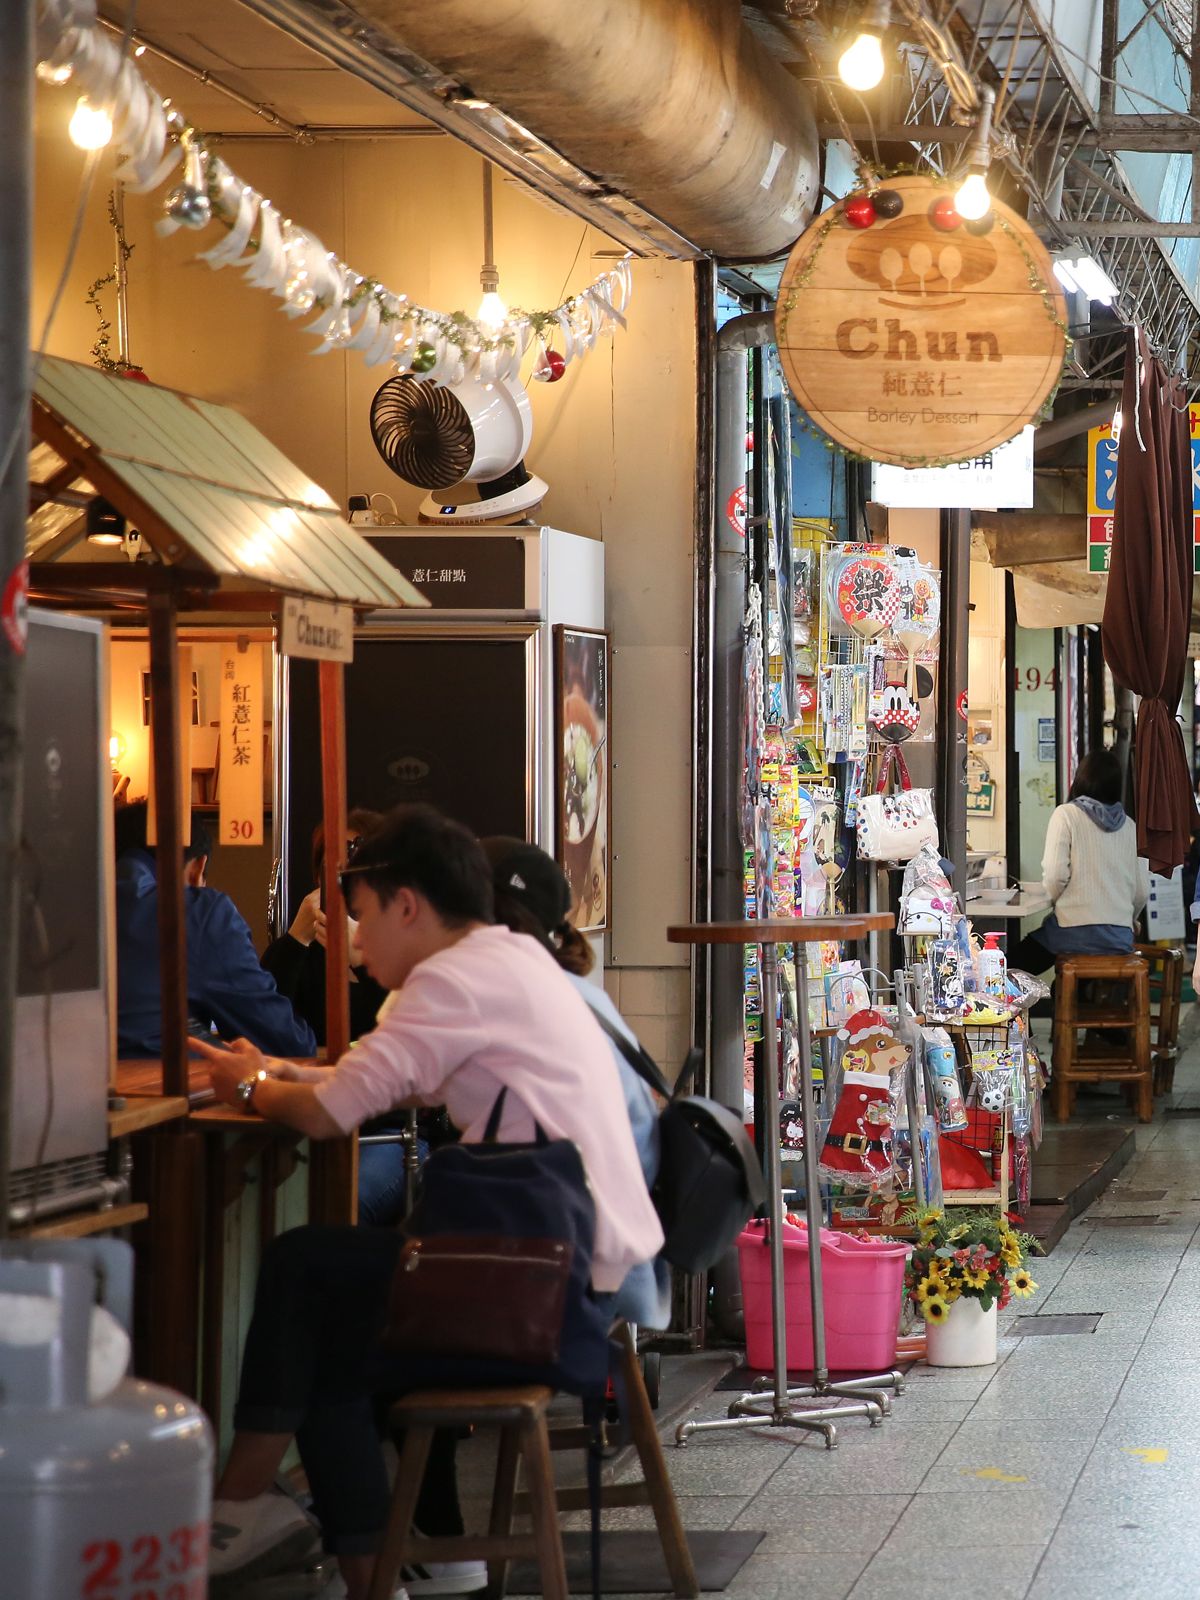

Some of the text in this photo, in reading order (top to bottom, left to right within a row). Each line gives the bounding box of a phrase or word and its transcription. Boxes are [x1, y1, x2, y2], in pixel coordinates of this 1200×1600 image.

[836, 318, 1003, 362] Chun
[882, 370, 962, 398] 純薏仁
[868, 407, 978, 425] Barley Dessert
[412, 568, 467, 583] 薏仁甜點
[232, 684, 251, 766] 紅薏仁茶
[230, 820, 253, 839] 30
